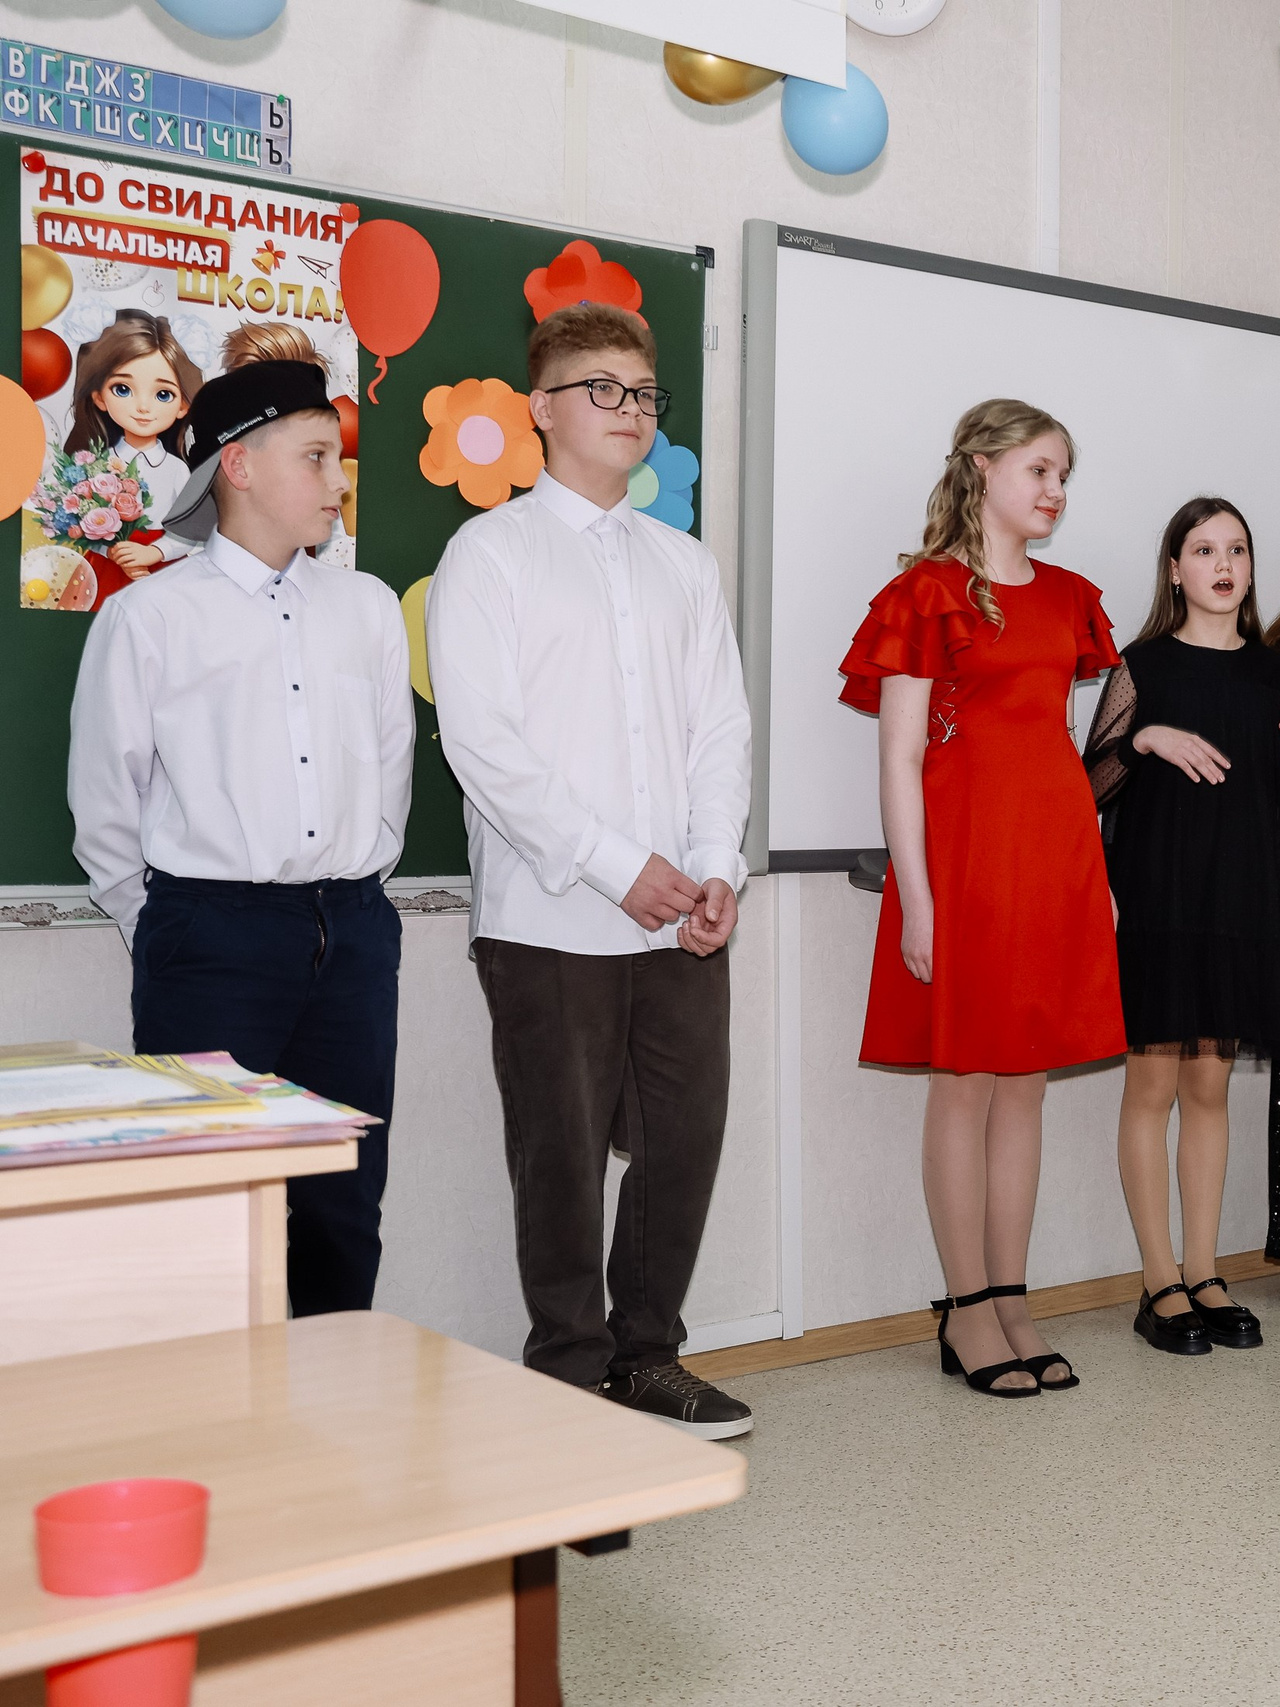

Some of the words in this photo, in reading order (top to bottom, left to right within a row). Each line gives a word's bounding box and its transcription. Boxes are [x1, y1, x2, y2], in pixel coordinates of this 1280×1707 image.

[8, 47, 26, 79] В
[40, 54, 57, 83] Г
[65, 60, 90, 96] Д
[94, 65, 121, 99] Ж
[128, 73, 145, 102] З
[269, 101, 284, 129] Ь
[3, 88, 30, 118] Ф
[38, 93, 59, 125] К
[69, 99, 87, 130] Т
[95, 104, 121, 137] Ш
[127, 112, 146, 142] С
[156, 116, 176, 147] Х
[184, 121, 204, 156] Ц
[212, 126, 230, 157] Ч
[236, 131, 261, 167] Щ
[265, 138, 283, 166] Ъ
[39, 165, 104, 206] ДО
[43, 218, 224, 269] НАЧАЛЬНАЯ
[784, 231, 814, 247] SMART
[177, 266, 345, 324] ШКОЛА!
